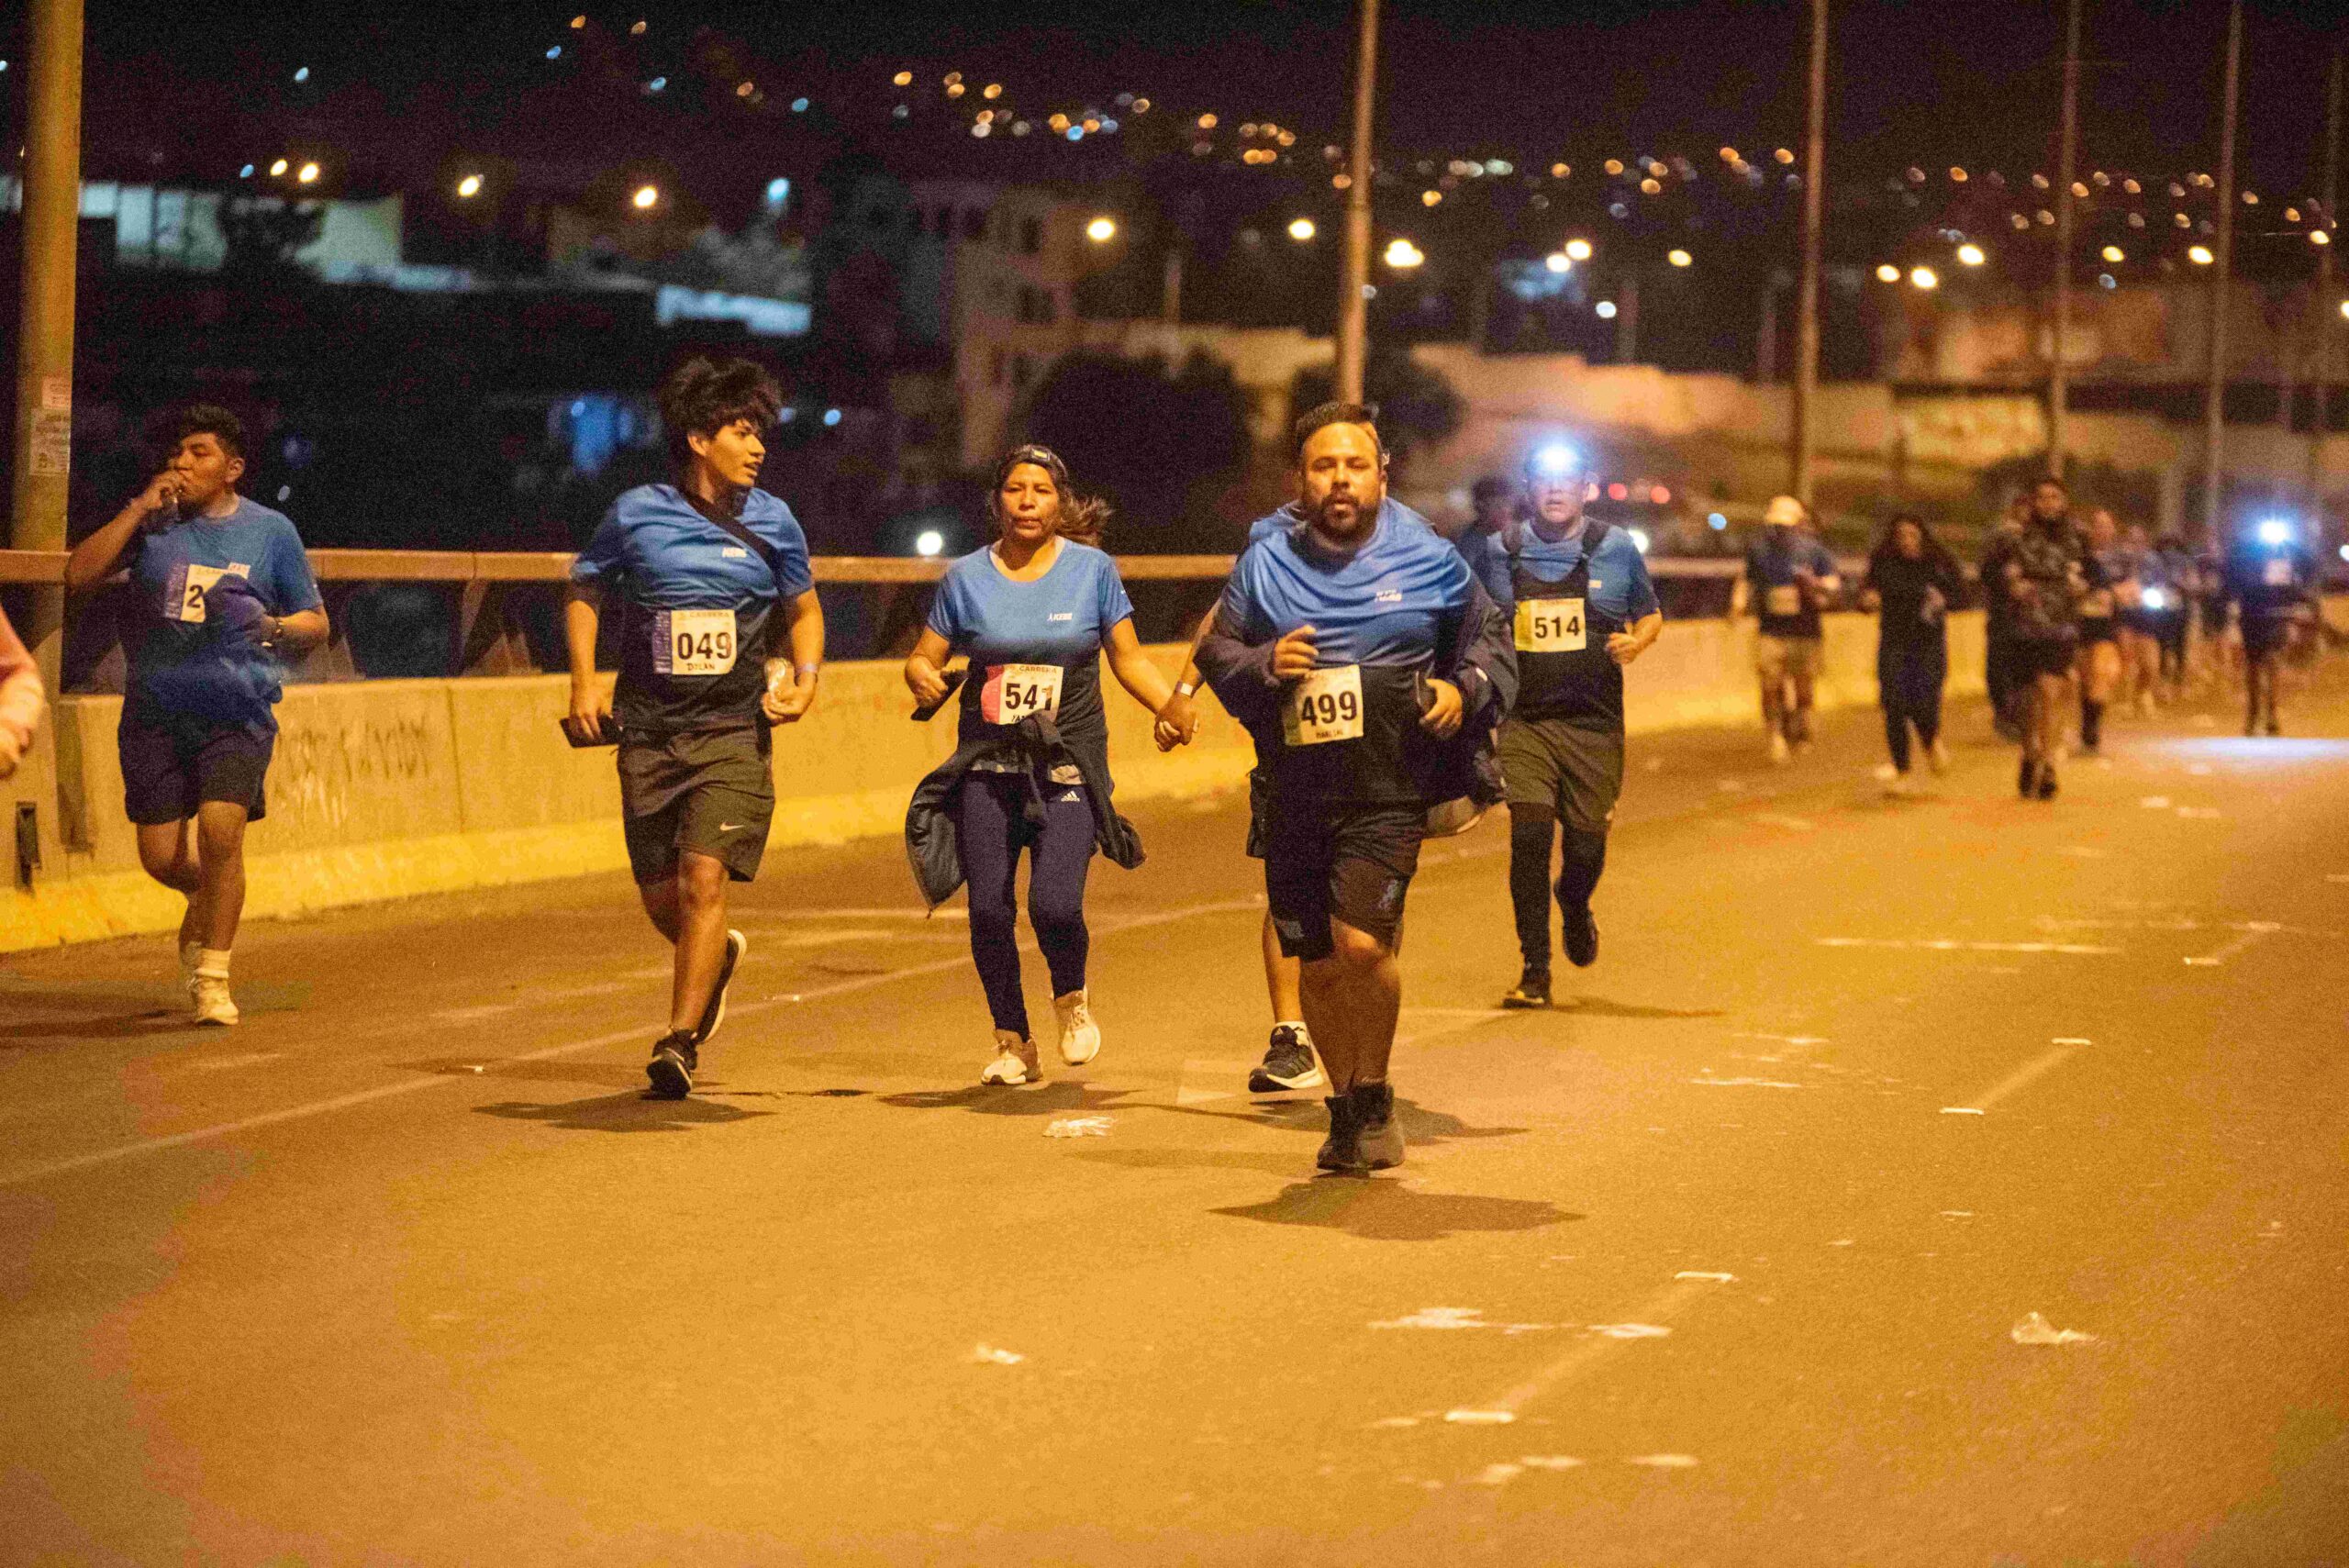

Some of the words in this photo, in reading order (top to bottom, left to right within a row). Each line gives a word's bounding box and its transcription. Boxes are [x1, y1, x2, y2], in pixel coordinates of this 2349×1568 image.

[1534, 616, 1581, 639] 514
[677, 632, 732, 660] 049
[1006, 683, 1054, 711] 541
[1301, 691, 1358, 727] 499
